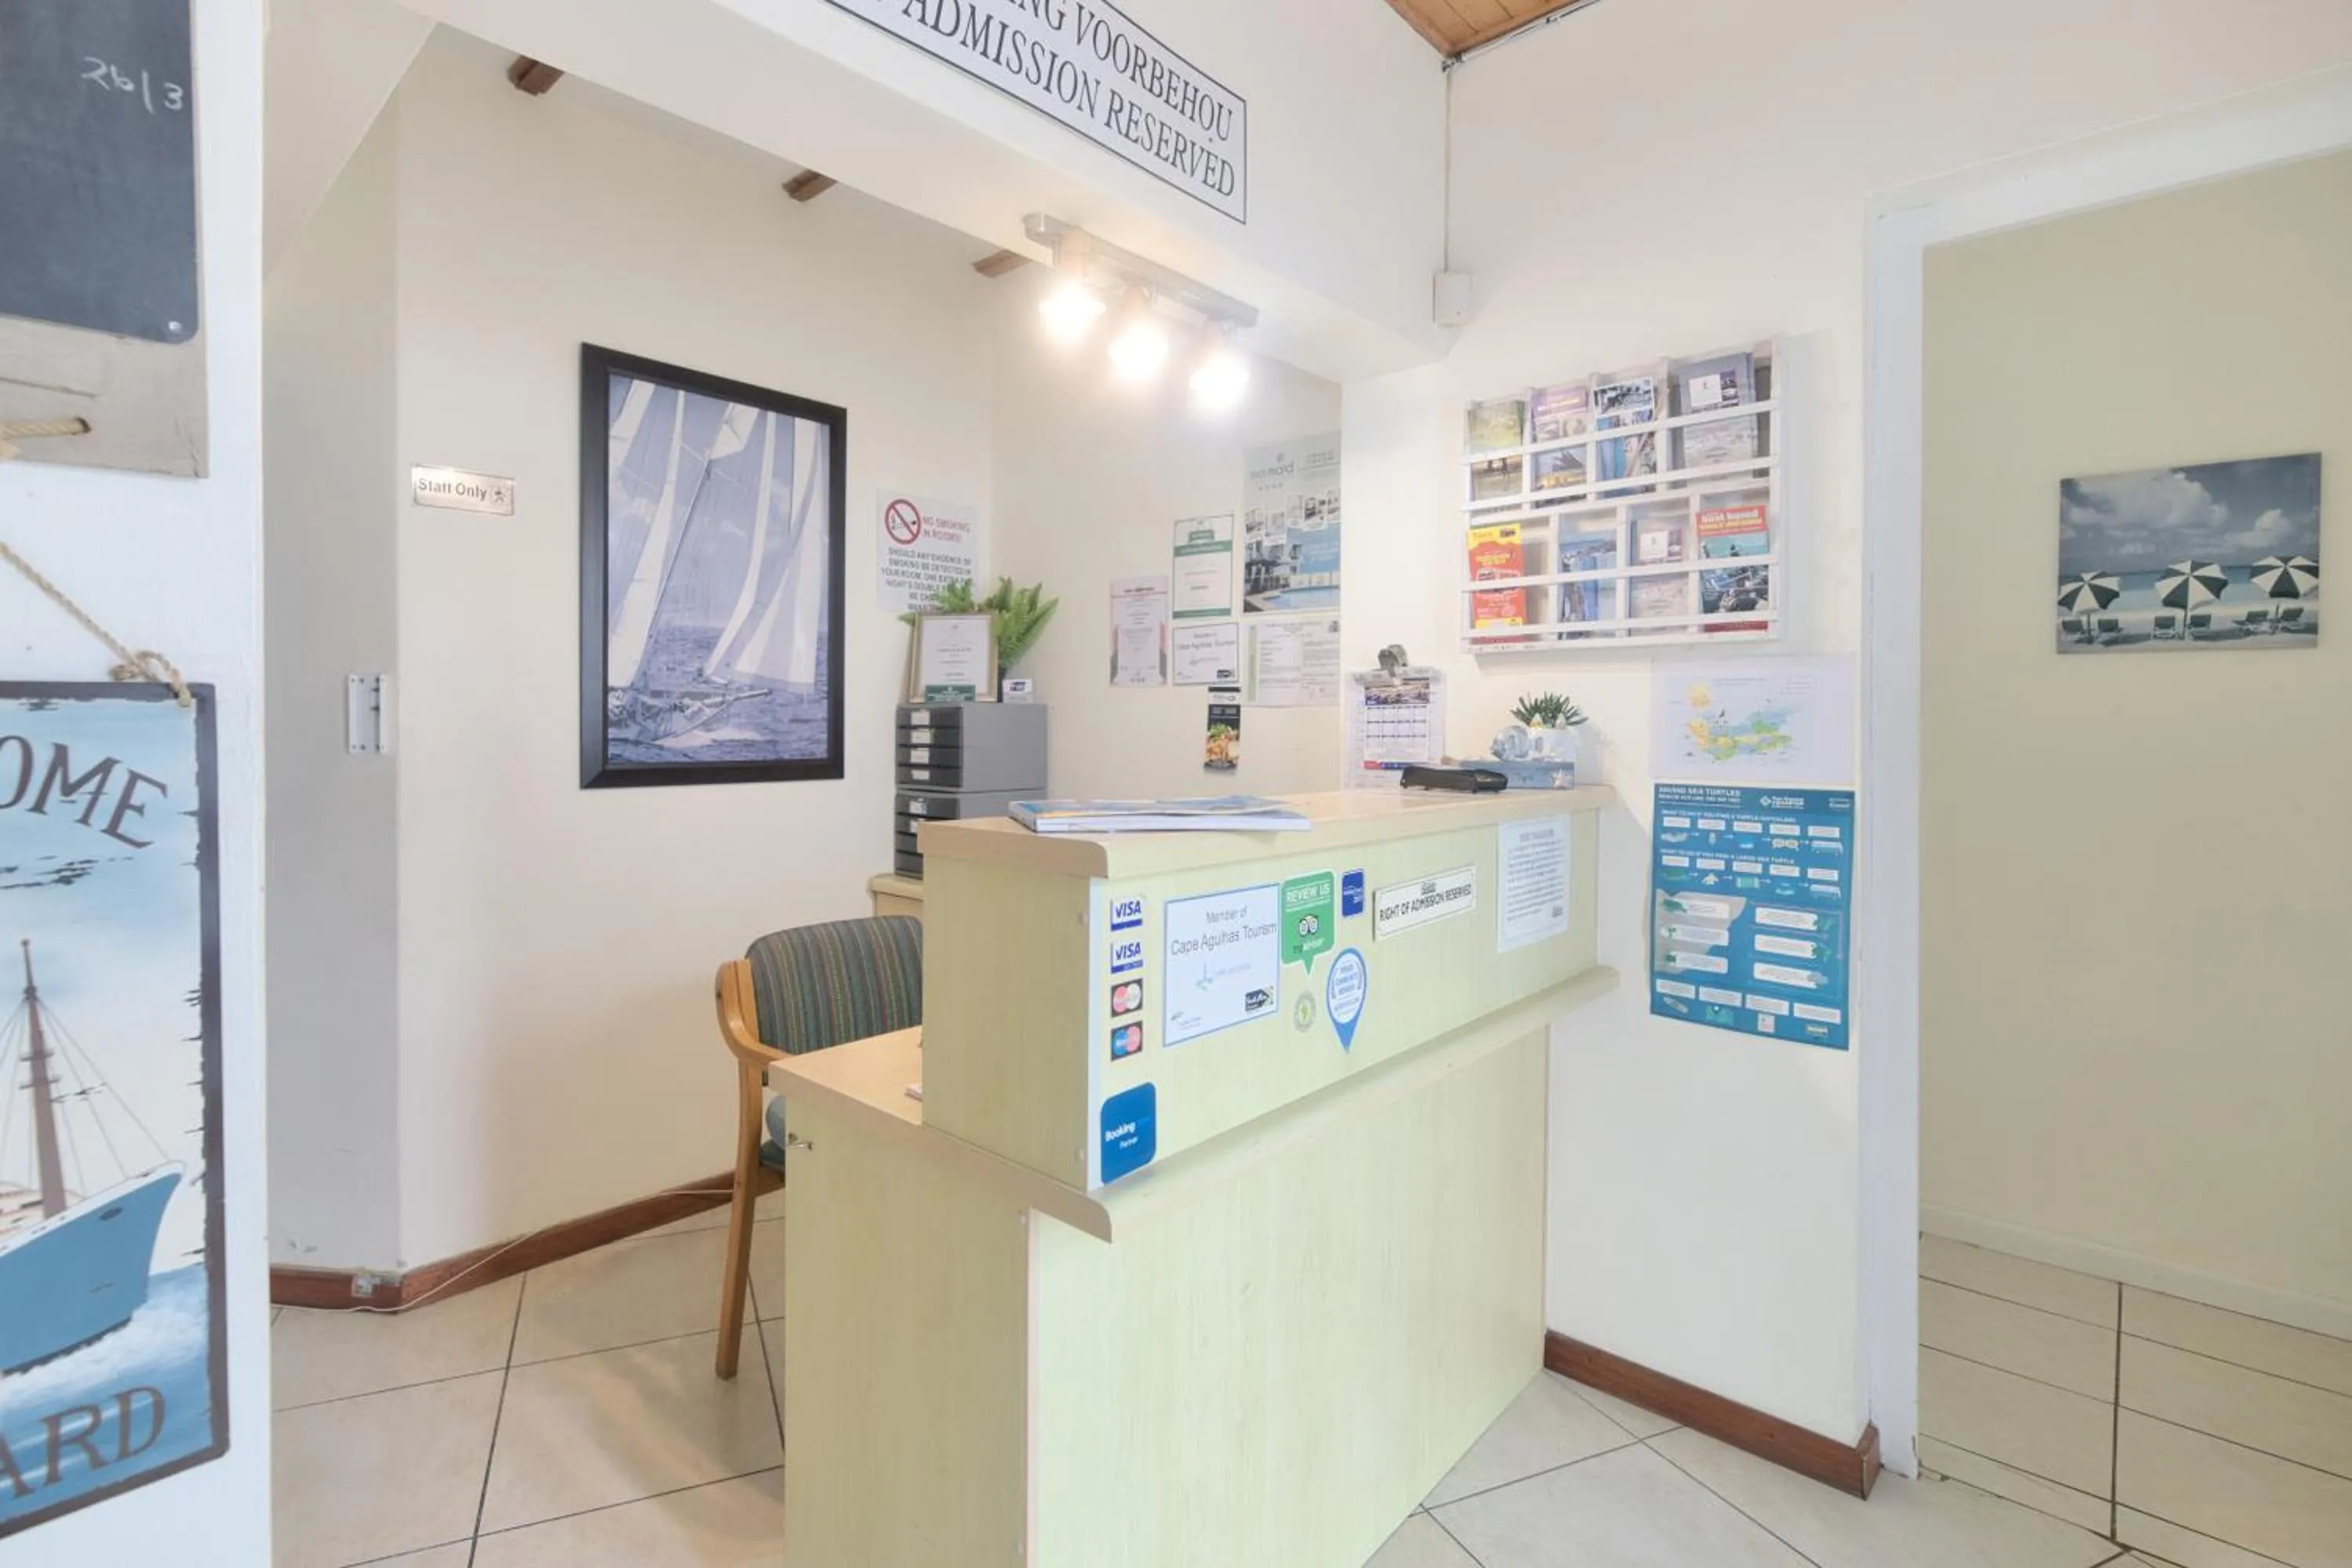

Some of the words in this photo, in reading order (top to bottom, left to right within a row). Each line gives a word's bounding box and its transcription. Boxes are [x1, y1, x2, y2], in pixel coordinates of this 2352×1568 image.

[1076, 2, 1232, 141] VOORBEHOU
[902, 0, 1101, 118] ADMISSION
[1104, 89, 1235, 197] RESERVED
[456, 482, 488, 502] Only
[1116, 900, 1142, 918] VISA
[1116, 942, 1141, 960] VISA
[1171, 939, 1199, 956] Cape
